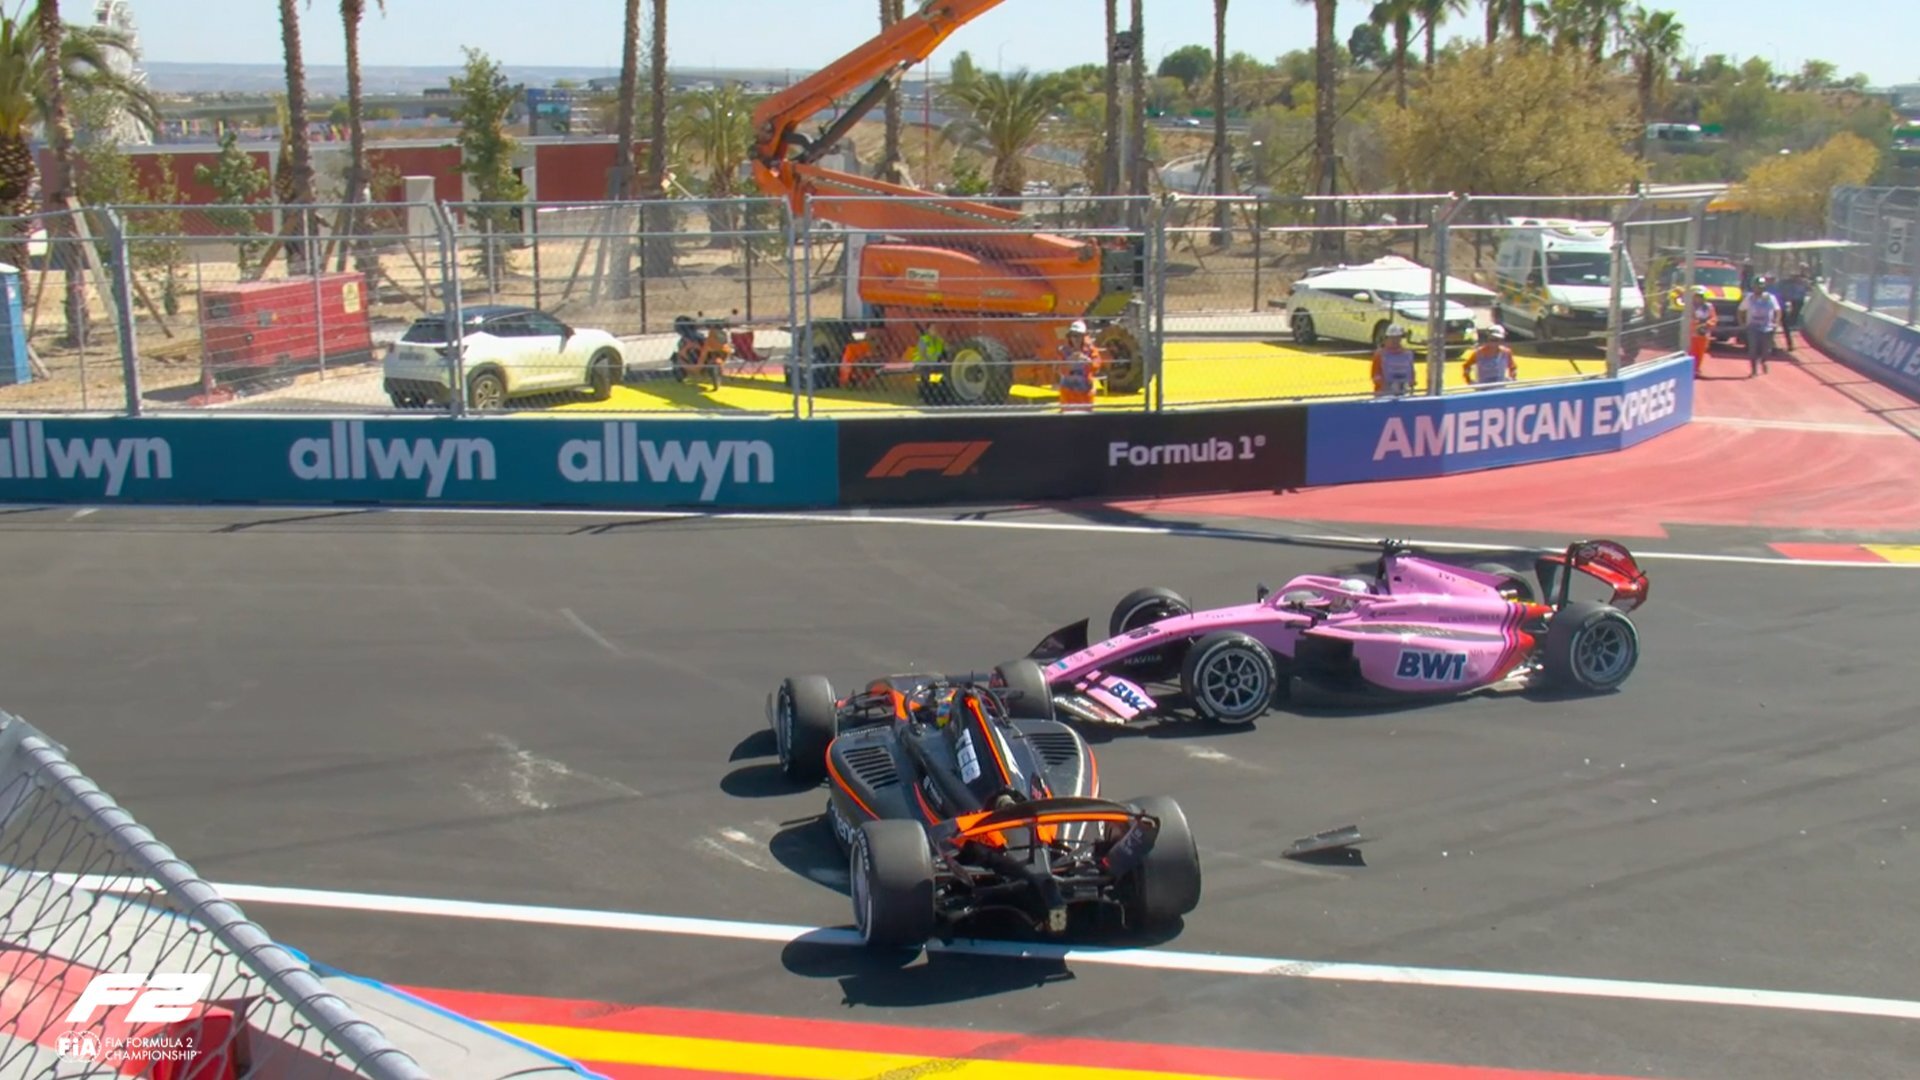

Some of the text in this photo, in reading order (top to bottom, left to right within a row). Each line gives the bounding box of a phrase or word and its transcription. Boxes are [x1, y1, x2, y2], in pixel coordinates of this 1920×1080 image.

[1108, 437, 1234, 467] Formula
[1373, 379, 1676, 461] AMERICAN EXPRESS
[0, 421, 172, 496] llwyn
[289, 421, 497, 498] allwyn
[557, 422, 775, 501] allwyn
[1396, 651, 1467, 681] BWT
